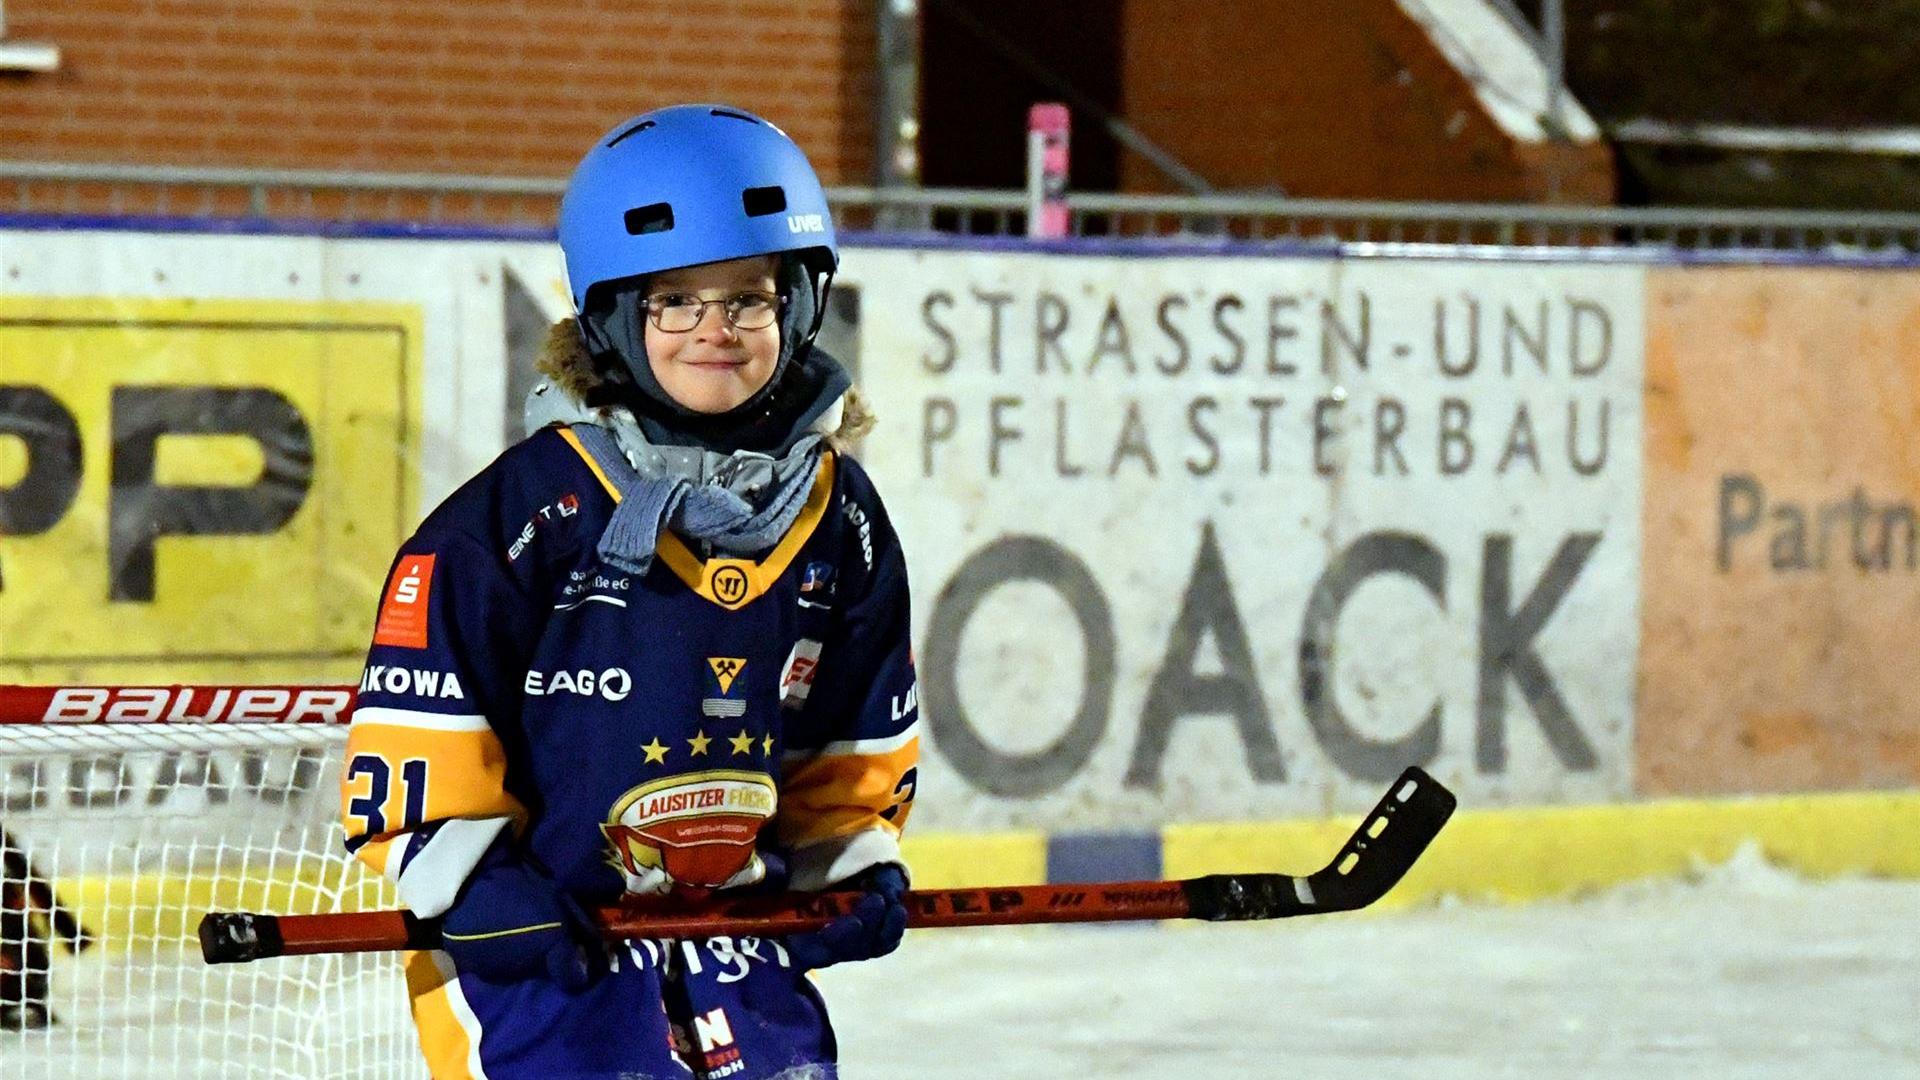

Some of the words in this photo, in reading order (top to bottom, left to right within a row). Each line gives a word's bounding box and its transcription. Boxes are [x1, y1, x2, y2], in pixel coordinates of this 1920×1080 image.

[787, 214, 824, 234] uvex
[921, 396, 1612, 478] PFLASTERBAU
[345, 754, 429, 853] 31
[639, 788, 725, 820] LAUSITZER
